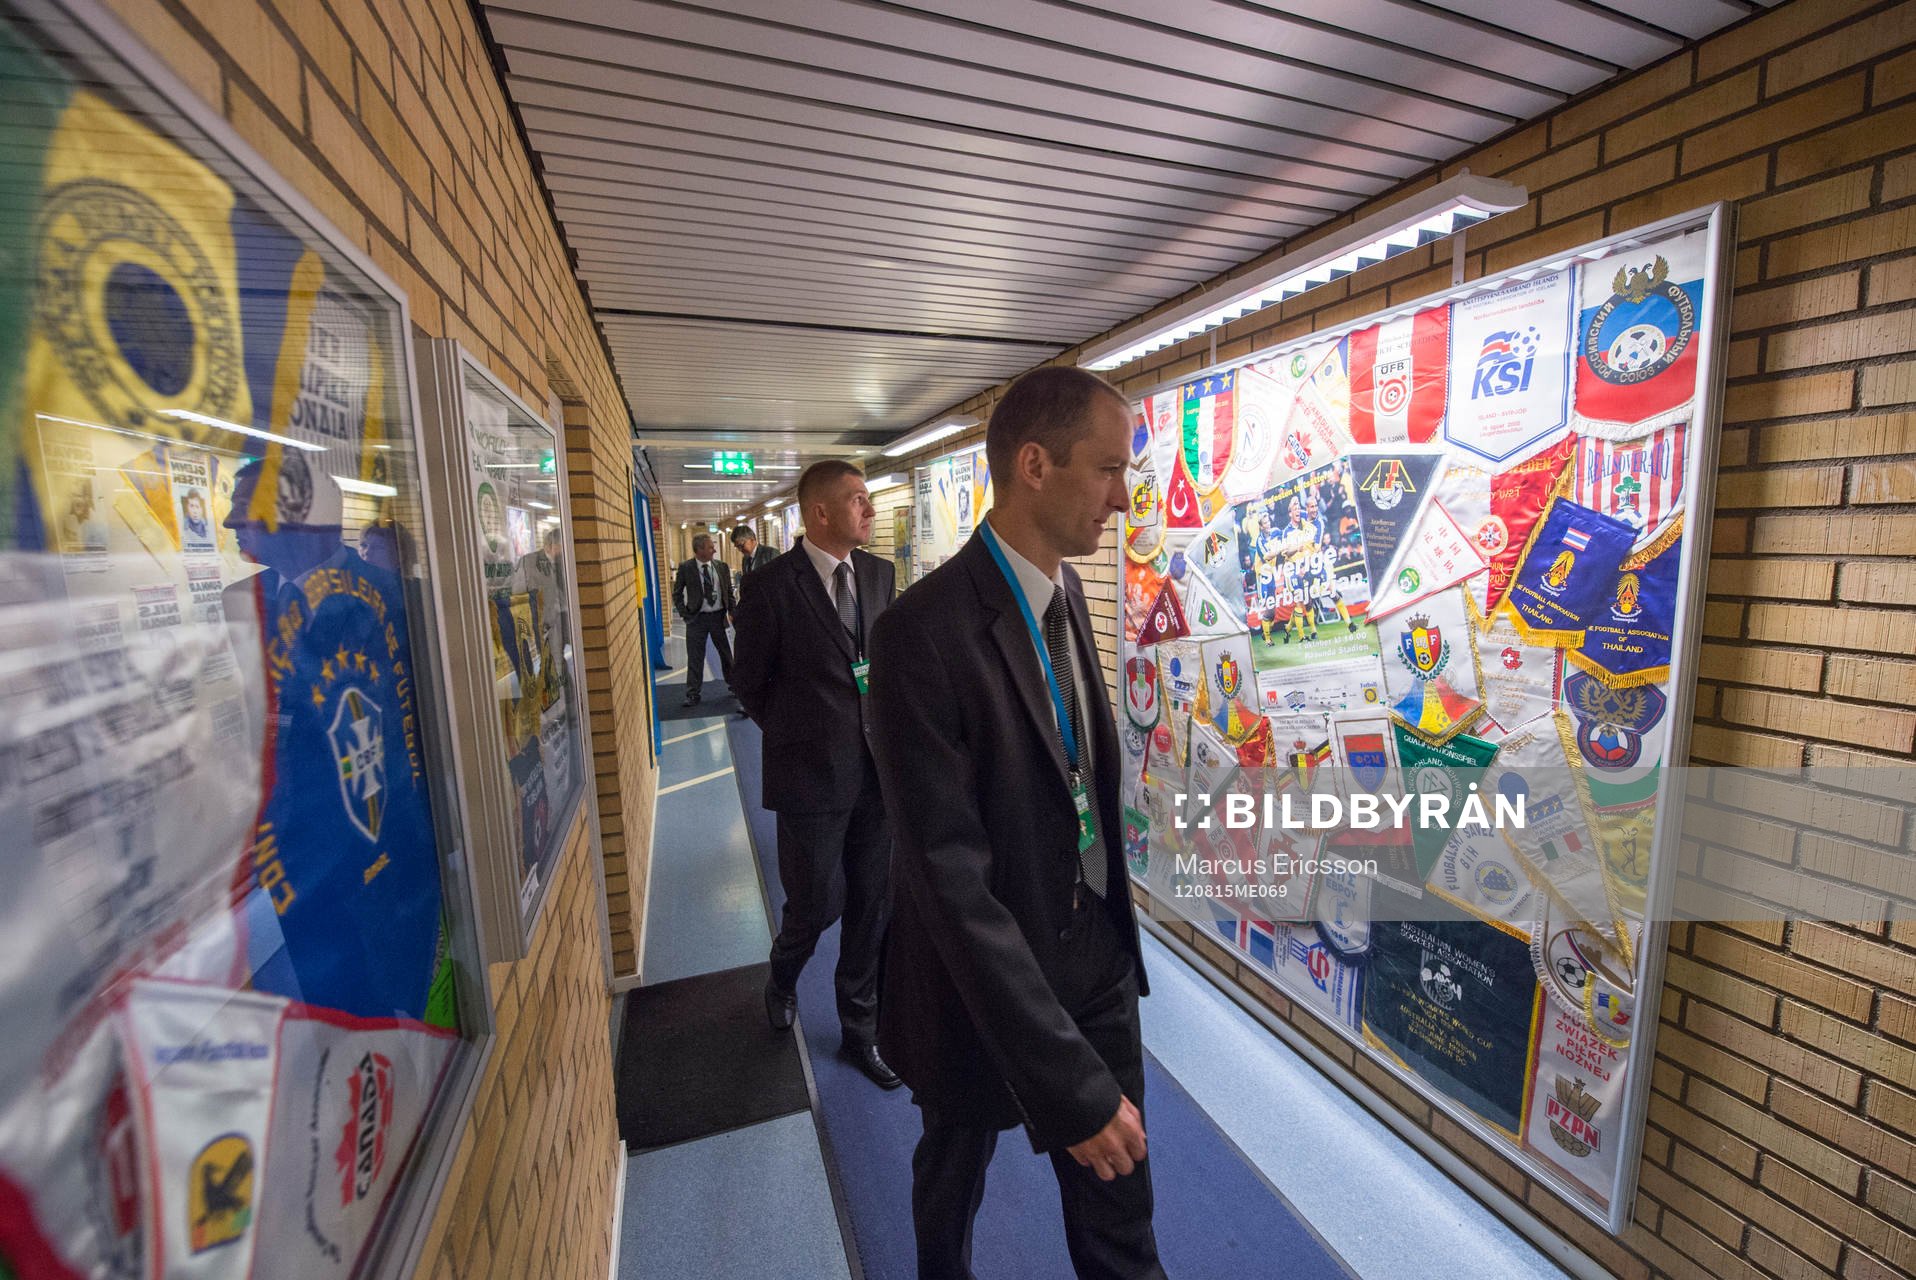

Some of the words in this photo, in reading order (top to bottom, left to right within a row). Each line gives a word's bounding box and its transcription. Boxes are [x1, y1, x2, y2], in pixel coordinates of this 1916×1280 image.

[1662, 285, 1694, 365] ФУТБОЛЬНЫЙ
[1620, 366, 1655, 382] СОЮЗ
[1261, 545, 1338, 585] Sverige
[1522, 603, 1553, 625] THAILAND
[1595, 625, 1625, 634] FOOTBALL
[1627, 629, 1669, 641] ASSOCIATION
[1602, 642, 1644, 653] THAILAND
[1443, 833, 1464, 890] FUDBALSKI
[1508, 892, 1532, 918] PATRICK
[1400, 920, 1452, 953] AUSTRALIAN
[1400, 928, 1434, 951] SOCCER
[1437, 948, 1494, 987] ASSOCIATION
[1556, 1044, 1611, 1082] NOŻNEJ
[1547, 1097, 1600, 1150] PZPN
